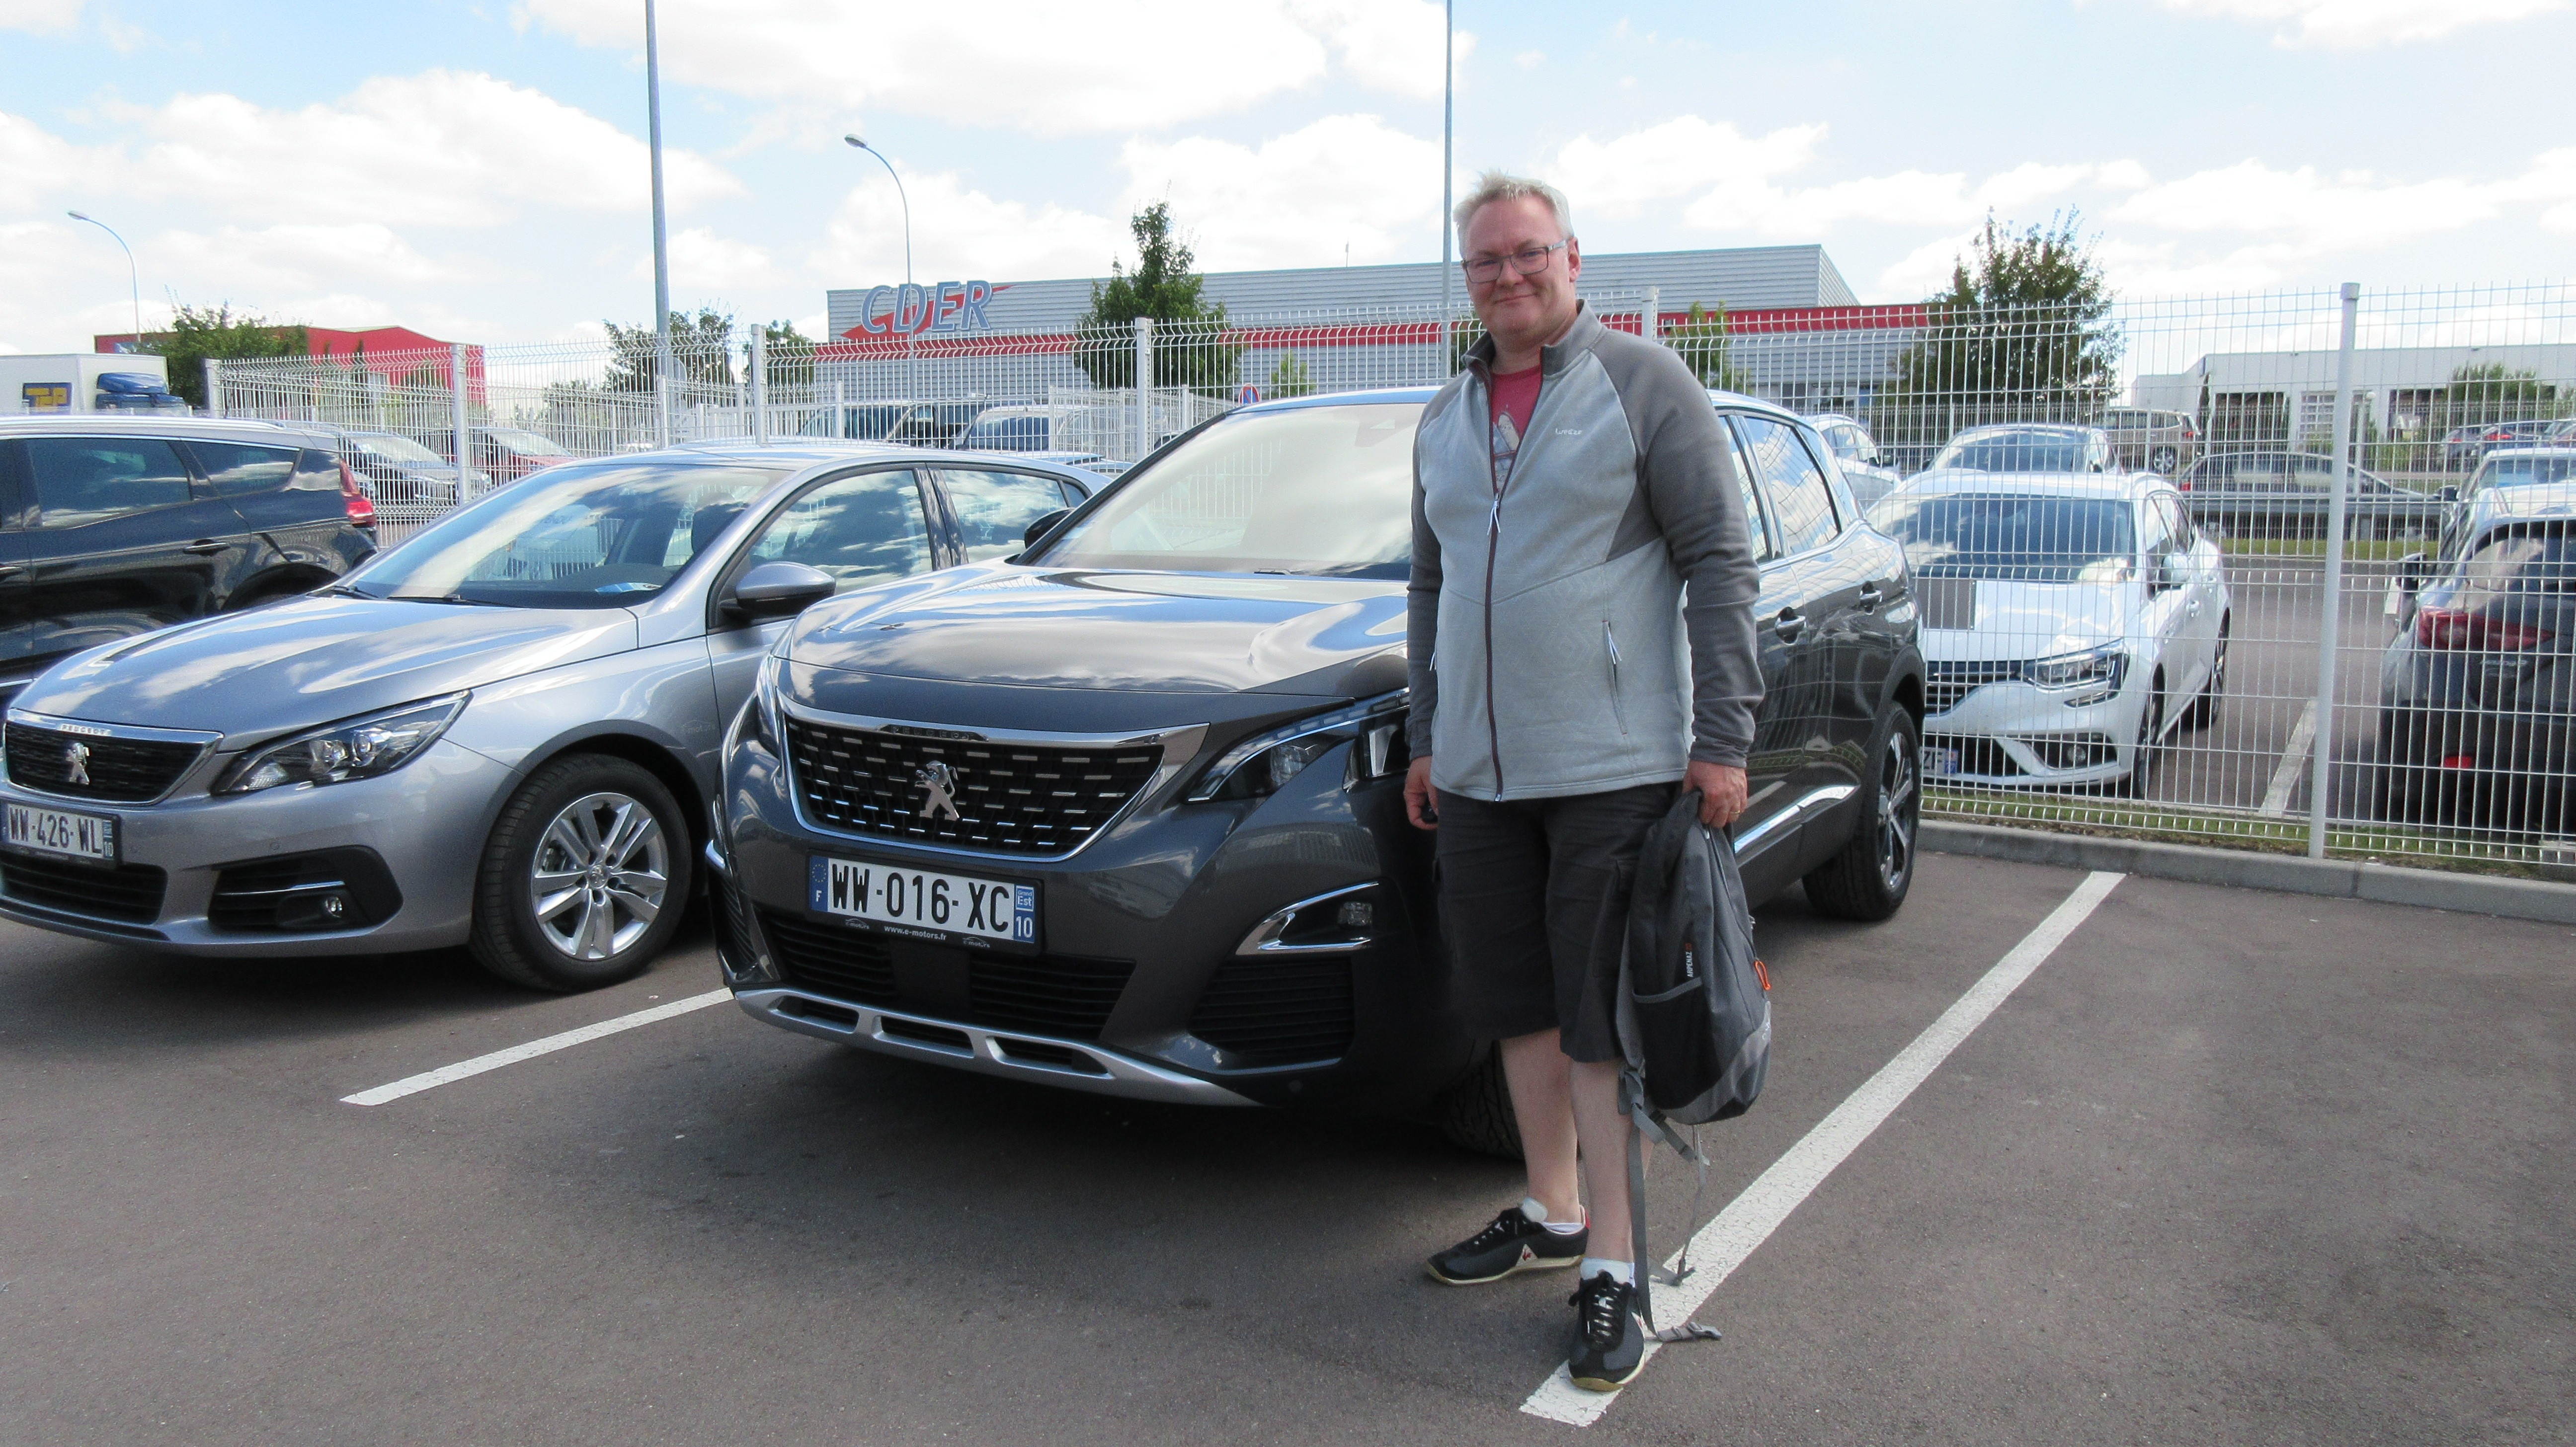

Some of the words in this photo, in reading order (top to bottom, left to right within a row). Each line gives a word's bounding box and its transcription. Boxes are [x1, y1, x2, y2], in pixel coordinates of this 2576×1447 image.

[861, 280, 993, 333] CDER
[62, 724, 105, 734] PEUGEOT
[890, 725, 973, 740] PEUGEOT
[9, 807, 102, 854] WW-426-WL
[104, 841, 114, 857] 10
[816, 890, 822, 902] F
[832, 864, 1010, 932] WW-016-XC
[1017, 896, 1032, 906] Est
[884, 926, 947, 940] www.e-motors.fr
[1016, 916, 1033, 938] 10
